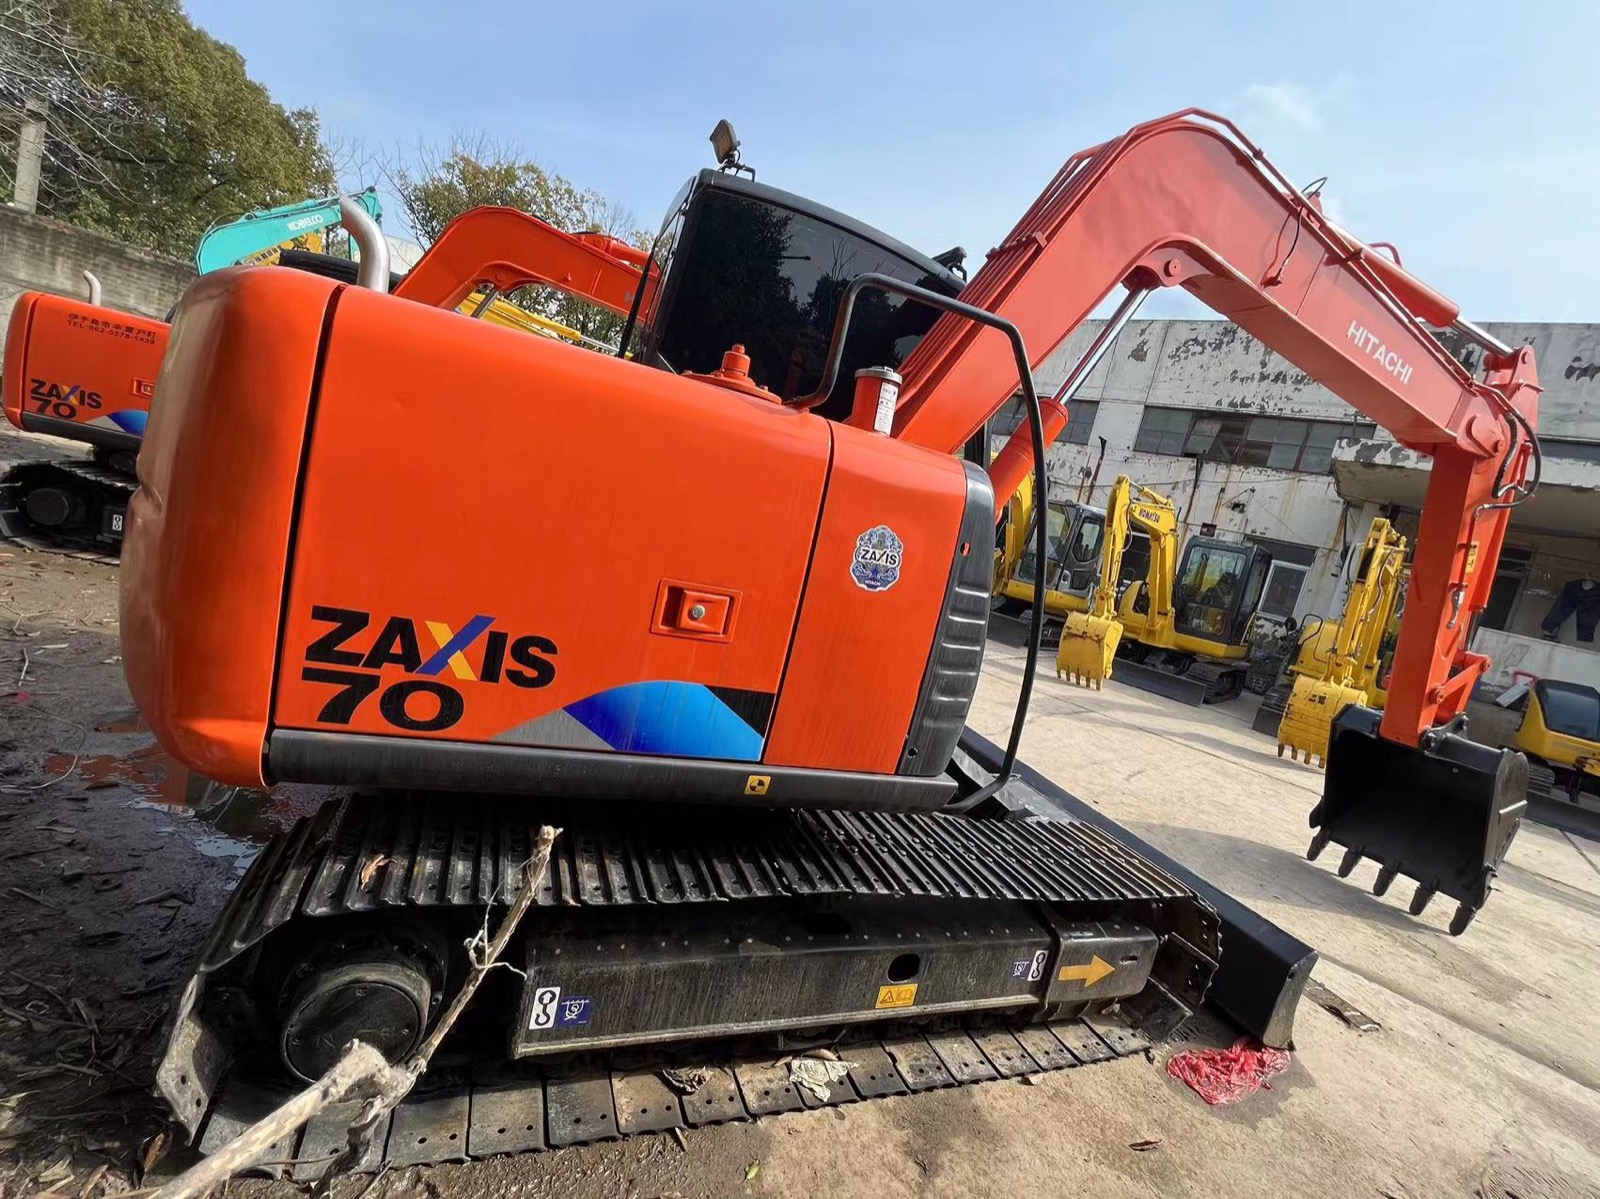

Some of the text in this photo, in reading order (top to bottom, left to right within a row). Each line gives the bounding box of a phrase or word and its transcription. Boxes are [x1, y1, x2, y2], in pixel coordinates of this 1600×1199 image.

[287, 214, 324, 232] KOBELCO
[1346, 319, 1413, 385] HITACHI
[30, 379, 103, 410] ZAXIS
[31, 395, 77, 420] 70
[860, 548, 898, 566] ZAXIS
[304, 604, 558, 689] ZAXIS
[301, 666, 465, 732] 70
